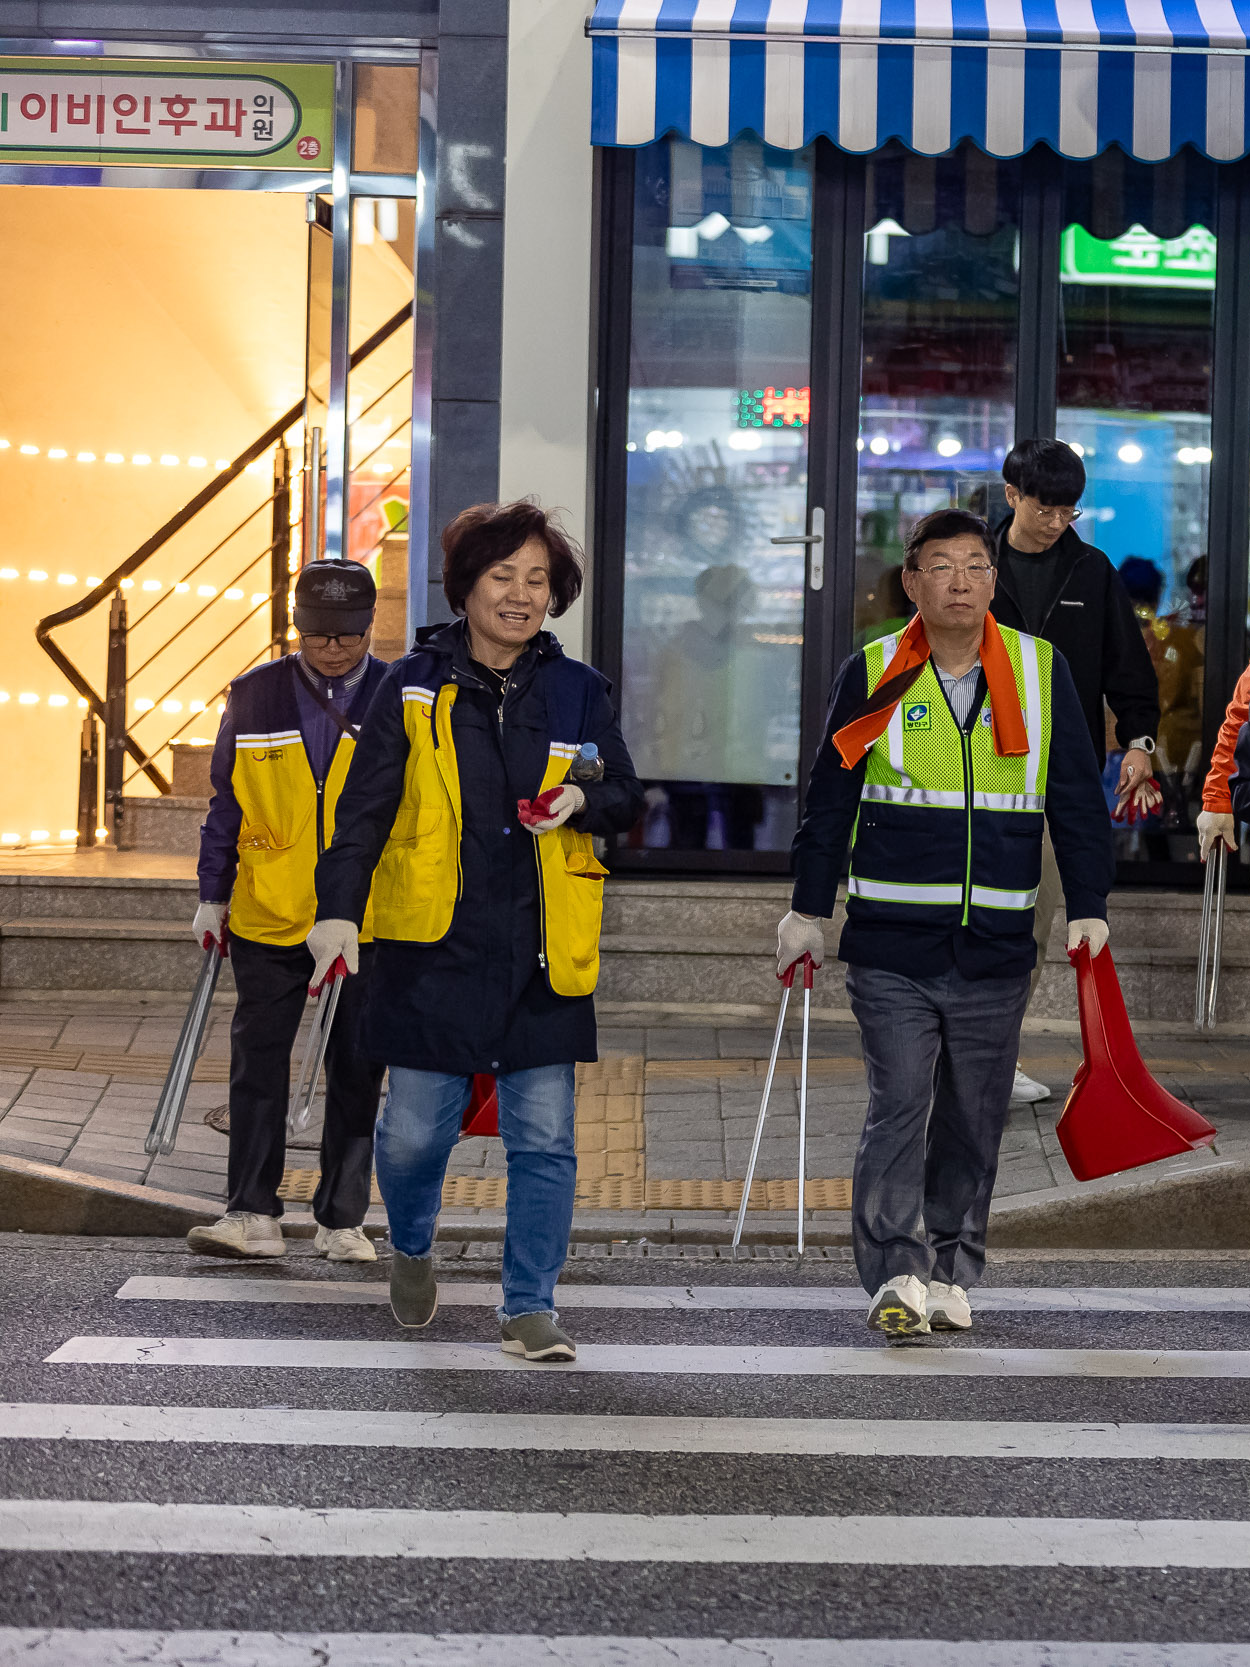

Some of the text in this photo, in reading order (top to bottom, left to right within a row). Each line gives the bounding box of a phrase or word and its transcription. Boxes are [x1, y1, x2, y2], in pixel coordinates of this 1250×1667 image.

[20, 93, 248, 138] 이비인후과
[252, 94, 275, 142] 의원
[299, 140, 320, 157] 2층
[907, 721, 928, 729] 광진구
